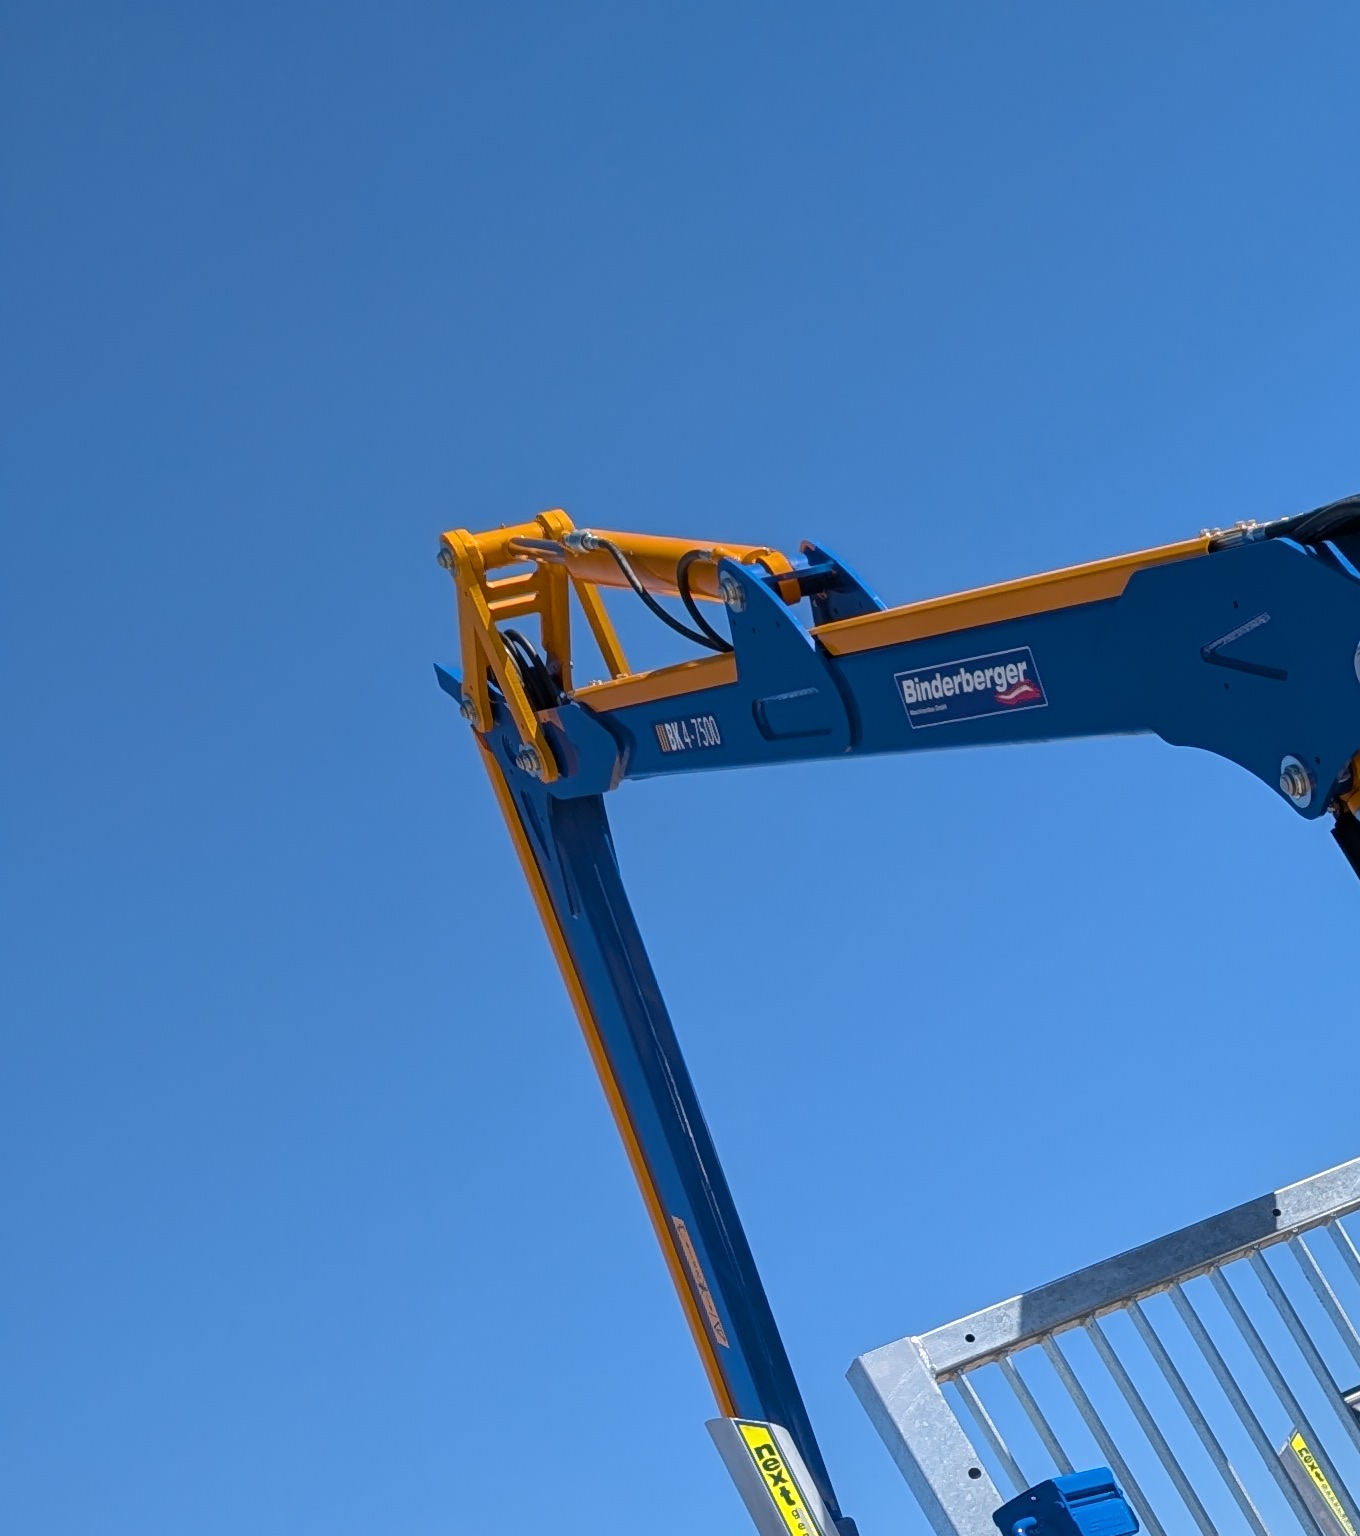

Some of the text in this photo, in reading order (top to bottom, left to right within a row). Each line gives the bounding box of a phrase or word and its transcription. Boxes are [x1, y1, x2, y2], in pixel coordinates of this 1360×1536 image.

[902, 660, 1028, 704] Binderberger
[664, 722, 686, 751] BK
[753, 1443, 796, 1506] next
[1298, 1447, 1324, 1482] next
